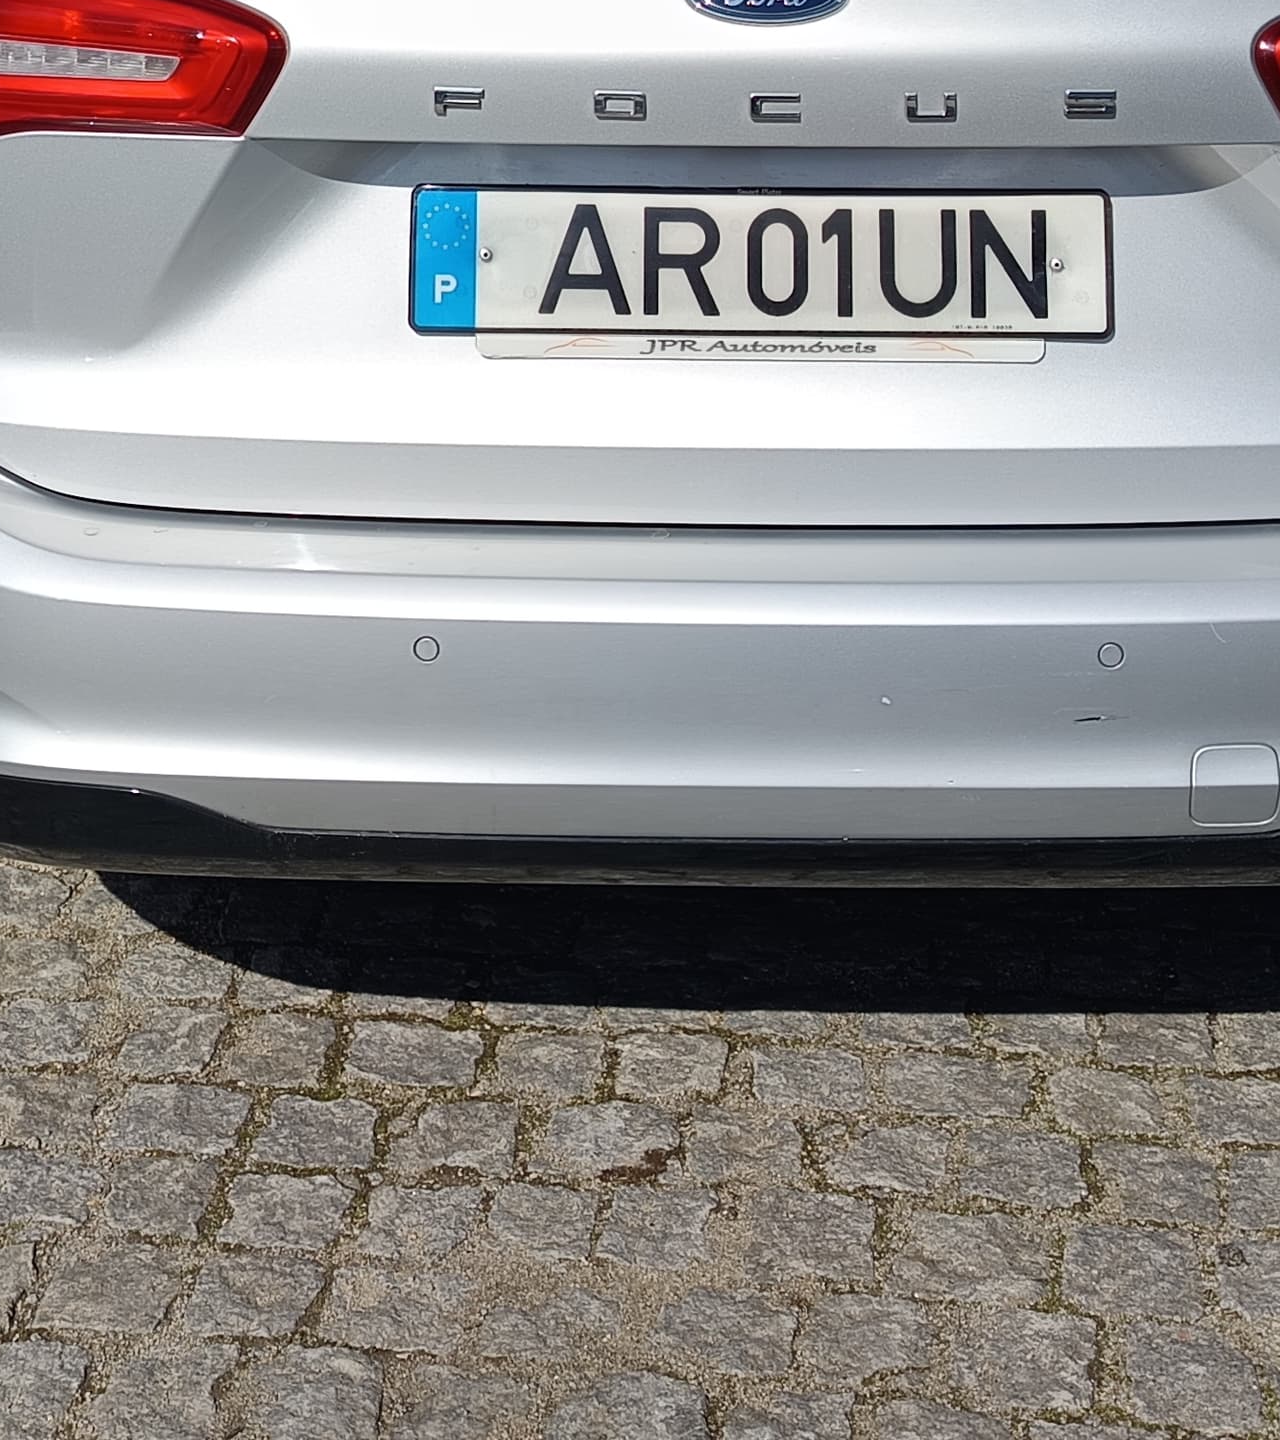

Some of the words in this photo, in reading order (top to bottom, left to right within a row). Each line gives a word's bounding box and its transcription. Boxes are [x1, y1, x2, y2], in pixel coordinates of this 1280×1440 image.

[433, 85, 1118, 123] FOCUS
[432, 273, 458, 304] P
[639, 338, 702, 355] JPR
[705, 338, 878, 355] Automóveis
